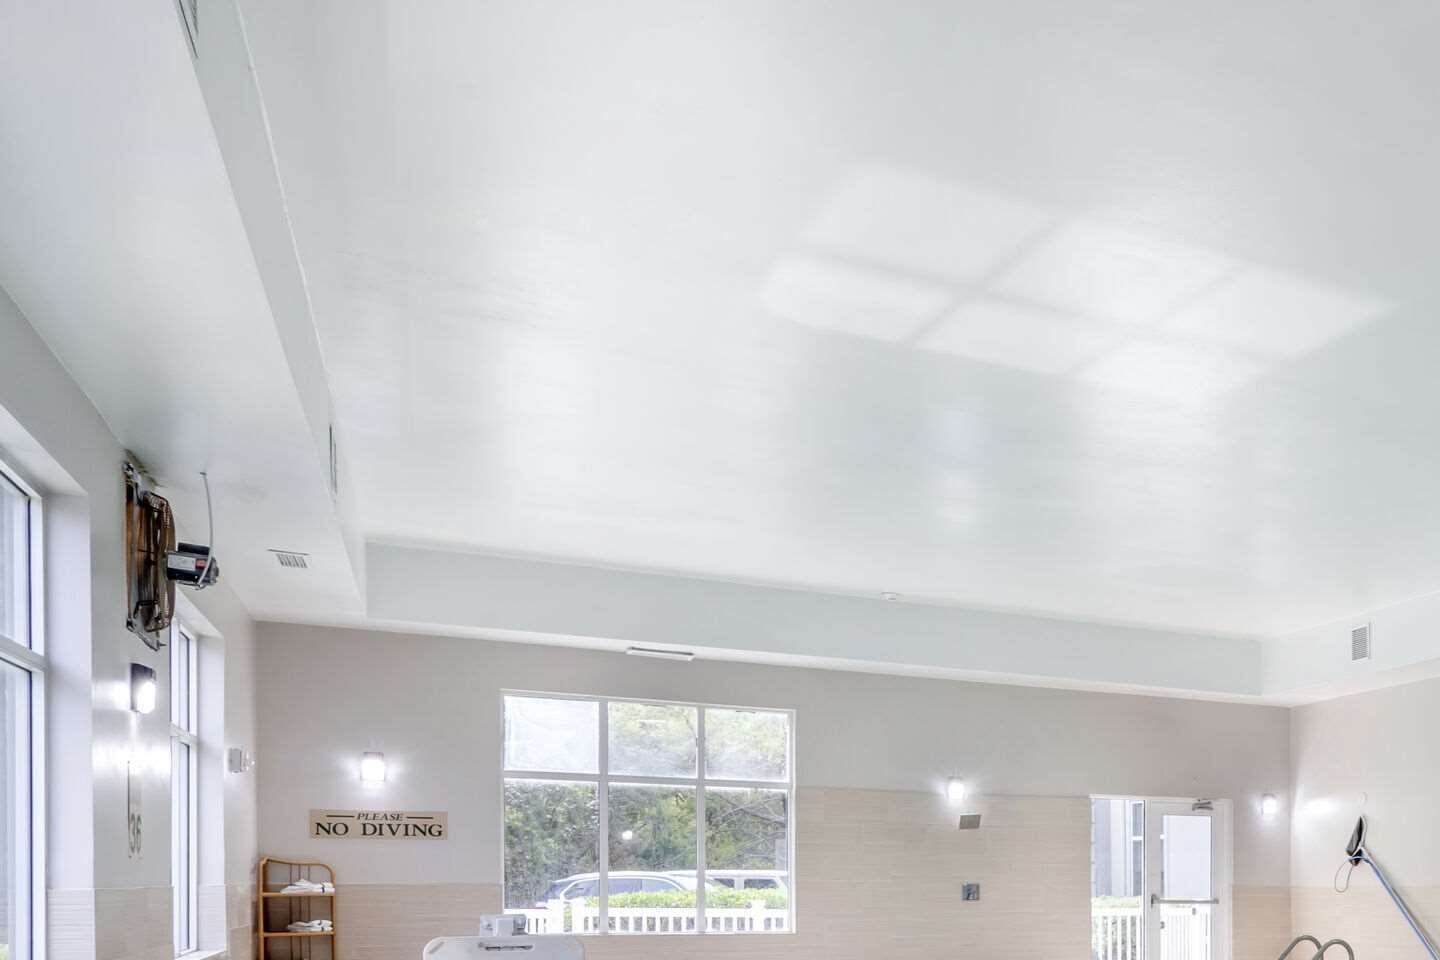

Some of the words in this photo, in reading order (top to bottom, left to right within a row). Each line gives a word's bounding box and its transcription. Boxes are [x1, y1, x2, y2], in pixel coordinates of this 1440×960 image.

[356, 812, 403, 821] PLEASE
[315, 822, 348, 836] NO
[361, 823, 443, 837] DIVING
